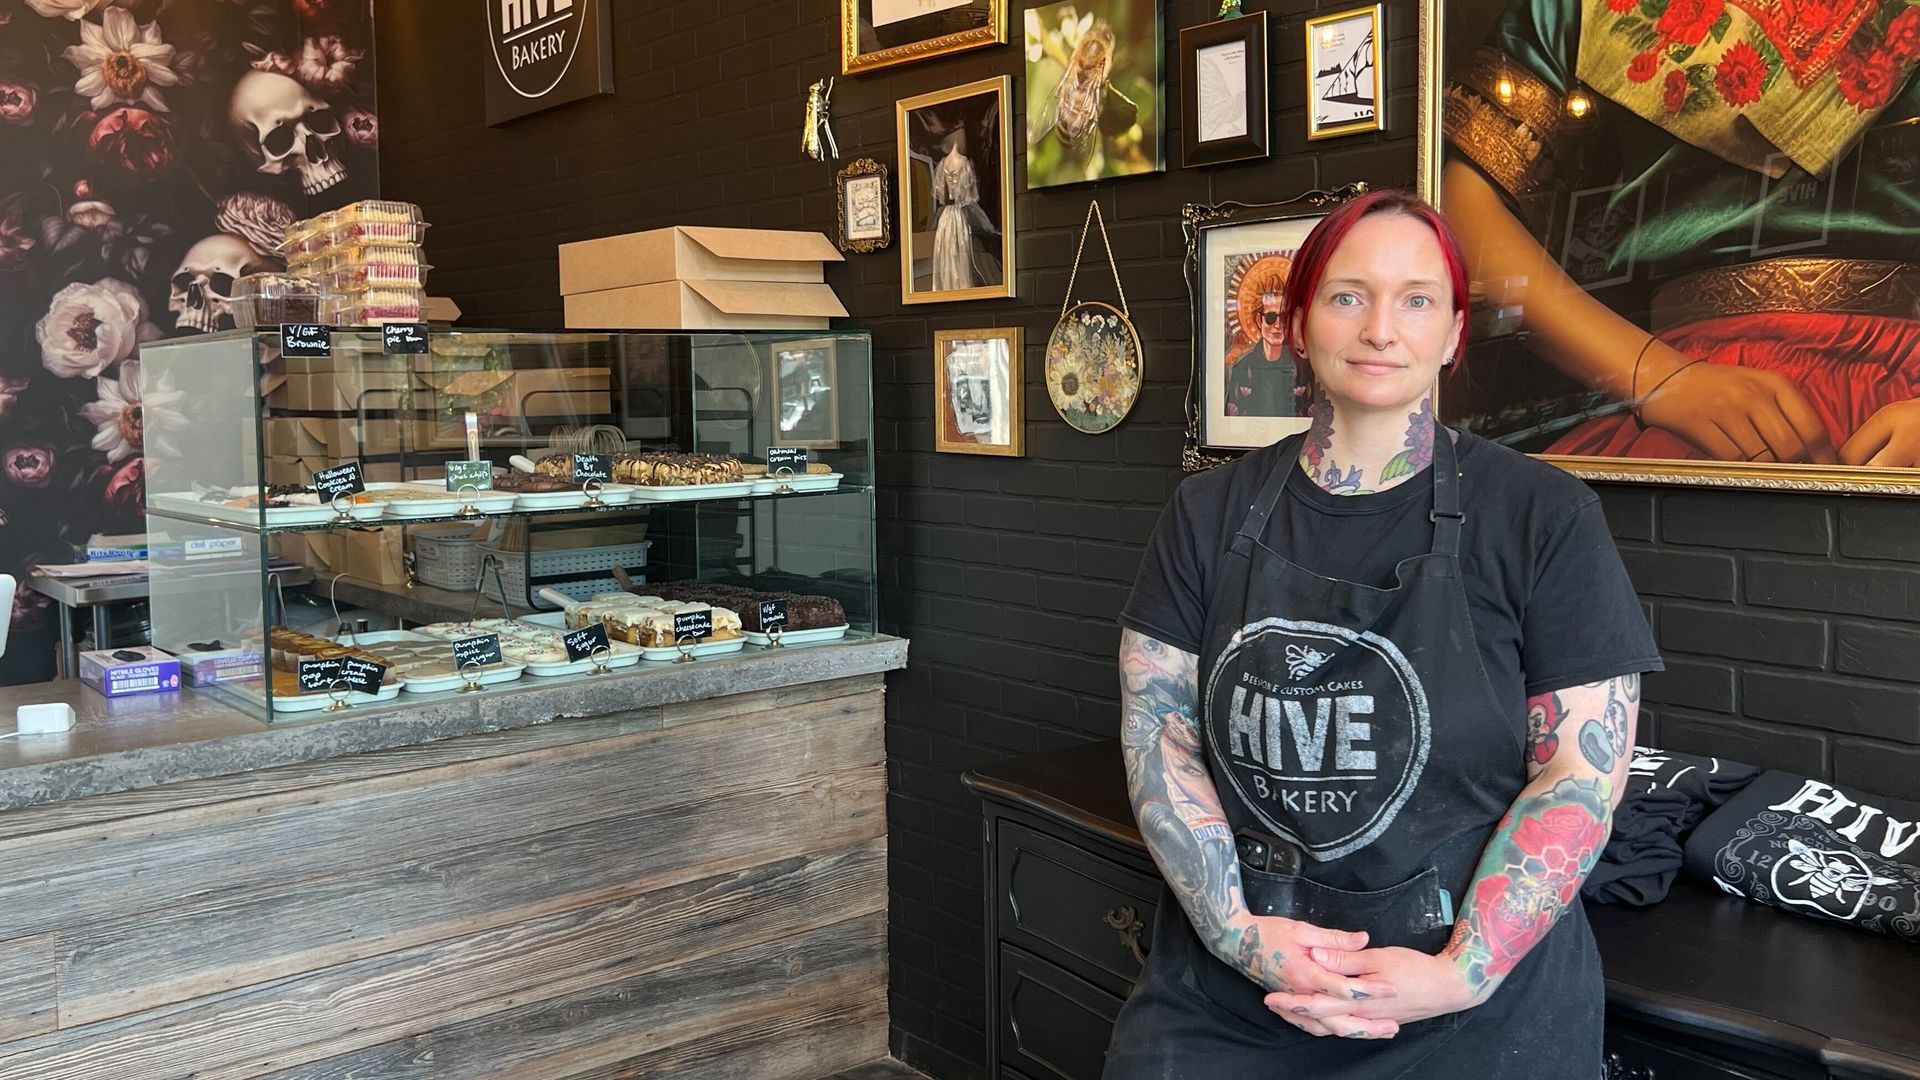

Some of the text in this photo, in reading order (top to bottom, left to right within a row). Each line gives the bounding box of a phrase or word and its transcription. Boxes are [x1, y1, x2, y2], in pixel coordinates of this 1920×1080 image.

[512, 29, 566, 71] BAKERY
[385, 325, 414, 336] Cherry
[286, 335, 330, 350] Brownie
[386, 335, 402, 347] pie
[575, 454, 599, 463] Death
[318, 466, 356, 481] Halloween
[575, 468, 608, 478] Chocolate
[317, 477, 348, 490] Cookies
[676, 613, 706, 625] pumpkin
[454, 638, 490, 652] pumpkin
[303, 660, 341, 672] pumpkin
[301, 672, 321, 684] pop
[1327, 680, 1364, 692] CAKES
[1228, 684, 1378, 773] HIVE
